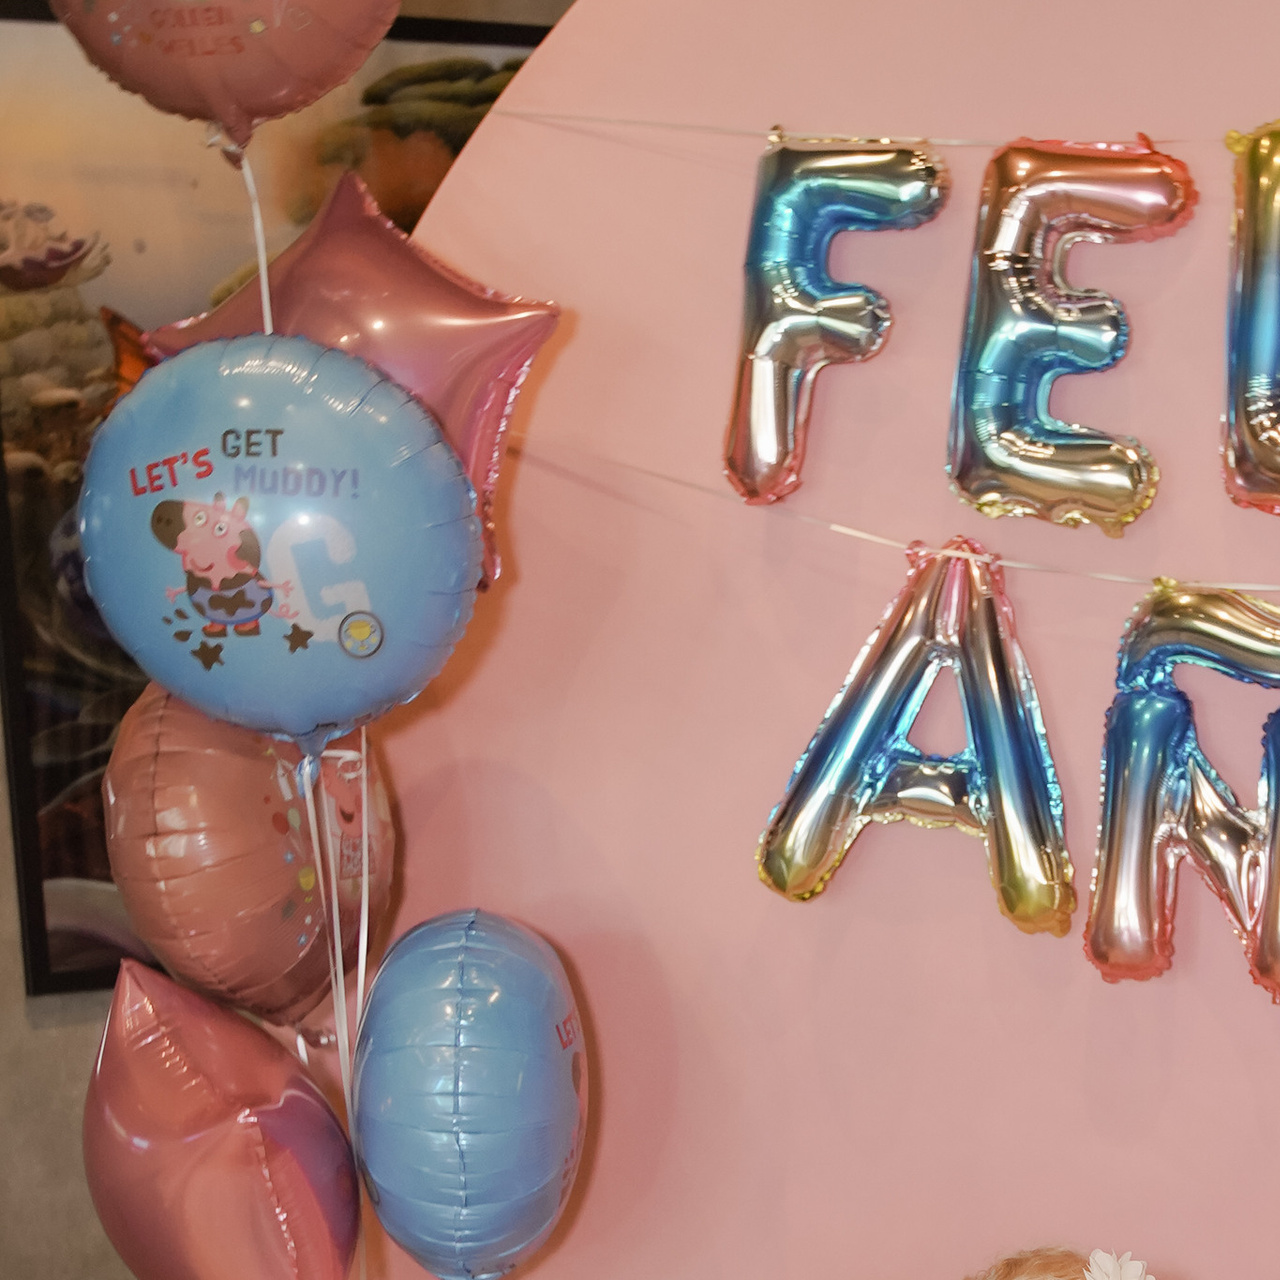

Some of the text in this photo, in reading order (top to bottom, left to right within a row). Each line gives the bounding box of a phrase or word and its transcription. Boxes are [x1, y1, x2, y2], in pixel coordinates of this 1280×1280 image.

[129, 429, 284, 496] LET'S GET
[232, 464, 360, 499] MUDDY!
